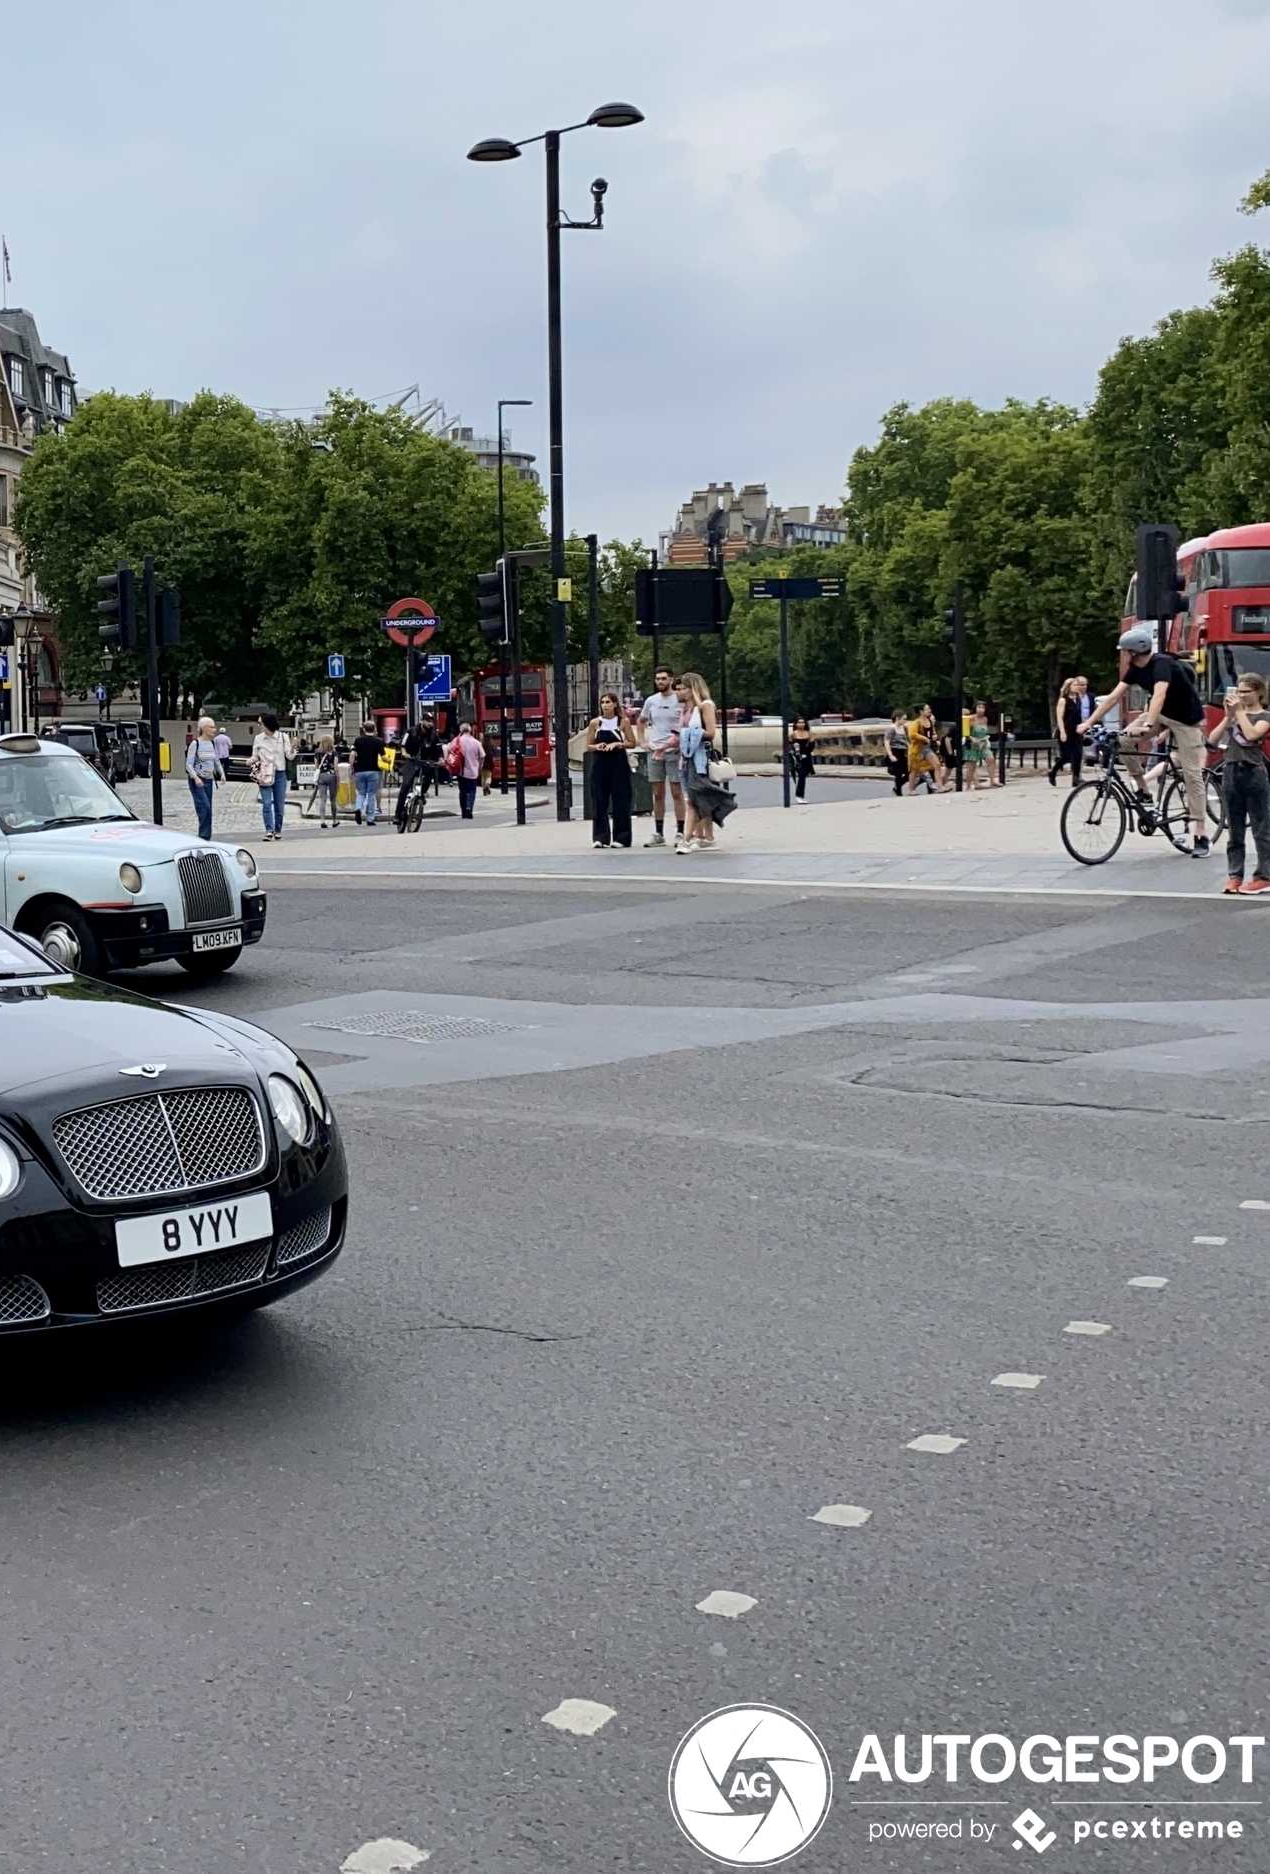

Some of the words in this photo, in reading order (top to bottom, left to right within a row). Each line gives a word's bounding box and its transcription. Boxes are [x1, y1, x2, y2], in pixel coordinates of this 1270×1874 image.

[385, 619, 436, 627] UNDERGROUND
[487, 724, 499, 733] 23
[195, 933, 221, 949] LM09
[222, 930, 239, 945] KFN
[162, 1218, 181, 1252] 8
[188, 1205, 238, 1247] YYY
